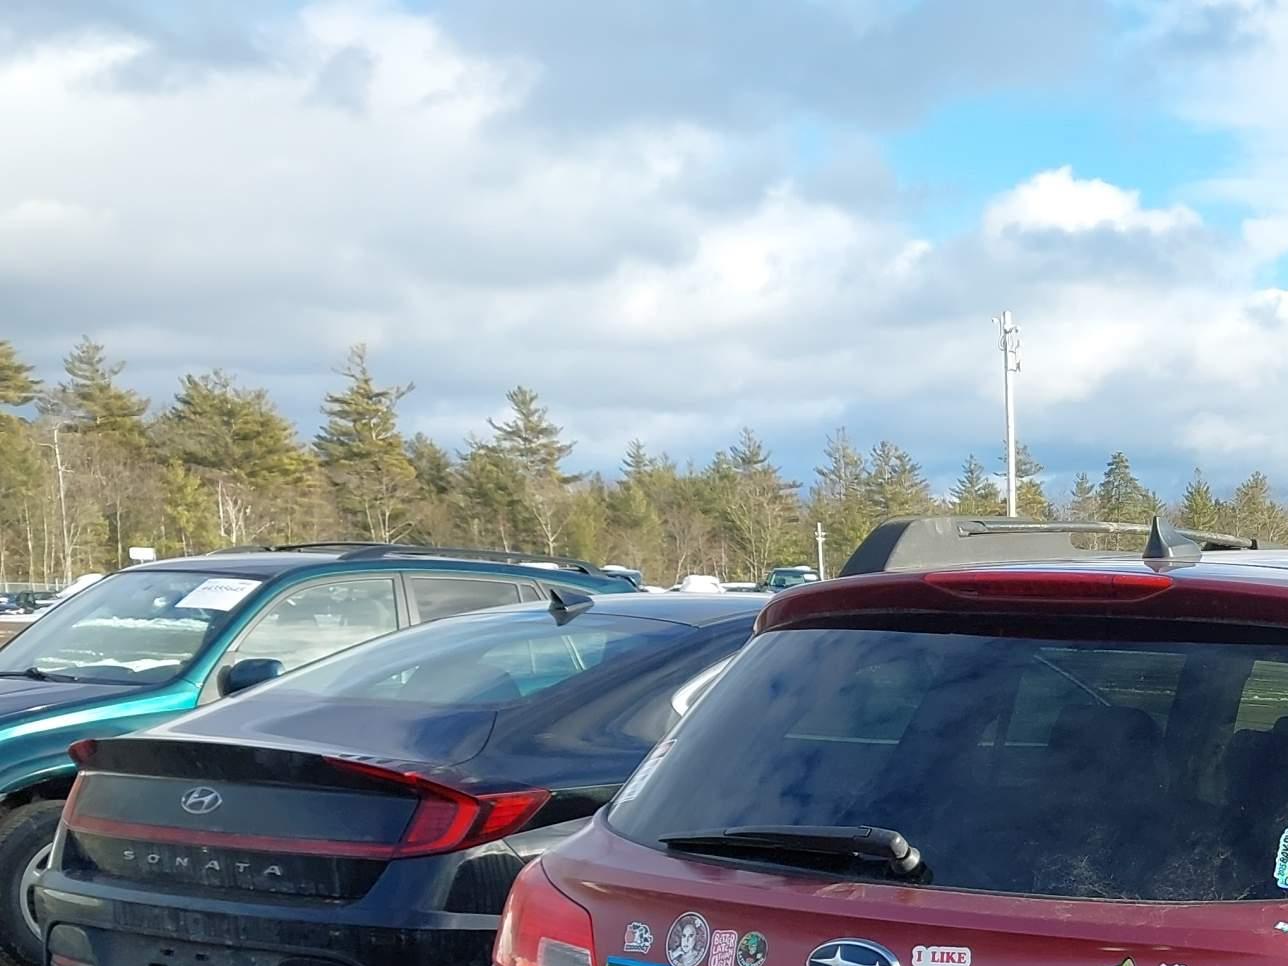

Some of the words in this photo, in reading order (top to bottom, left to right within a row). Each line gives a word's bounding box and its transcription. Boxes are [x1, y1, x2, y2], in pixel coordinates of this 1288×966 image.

[123, 850, 282, 876] SONATA
[916, 950, 923, 962] I
[931, 951, 967, 964] LIKE
